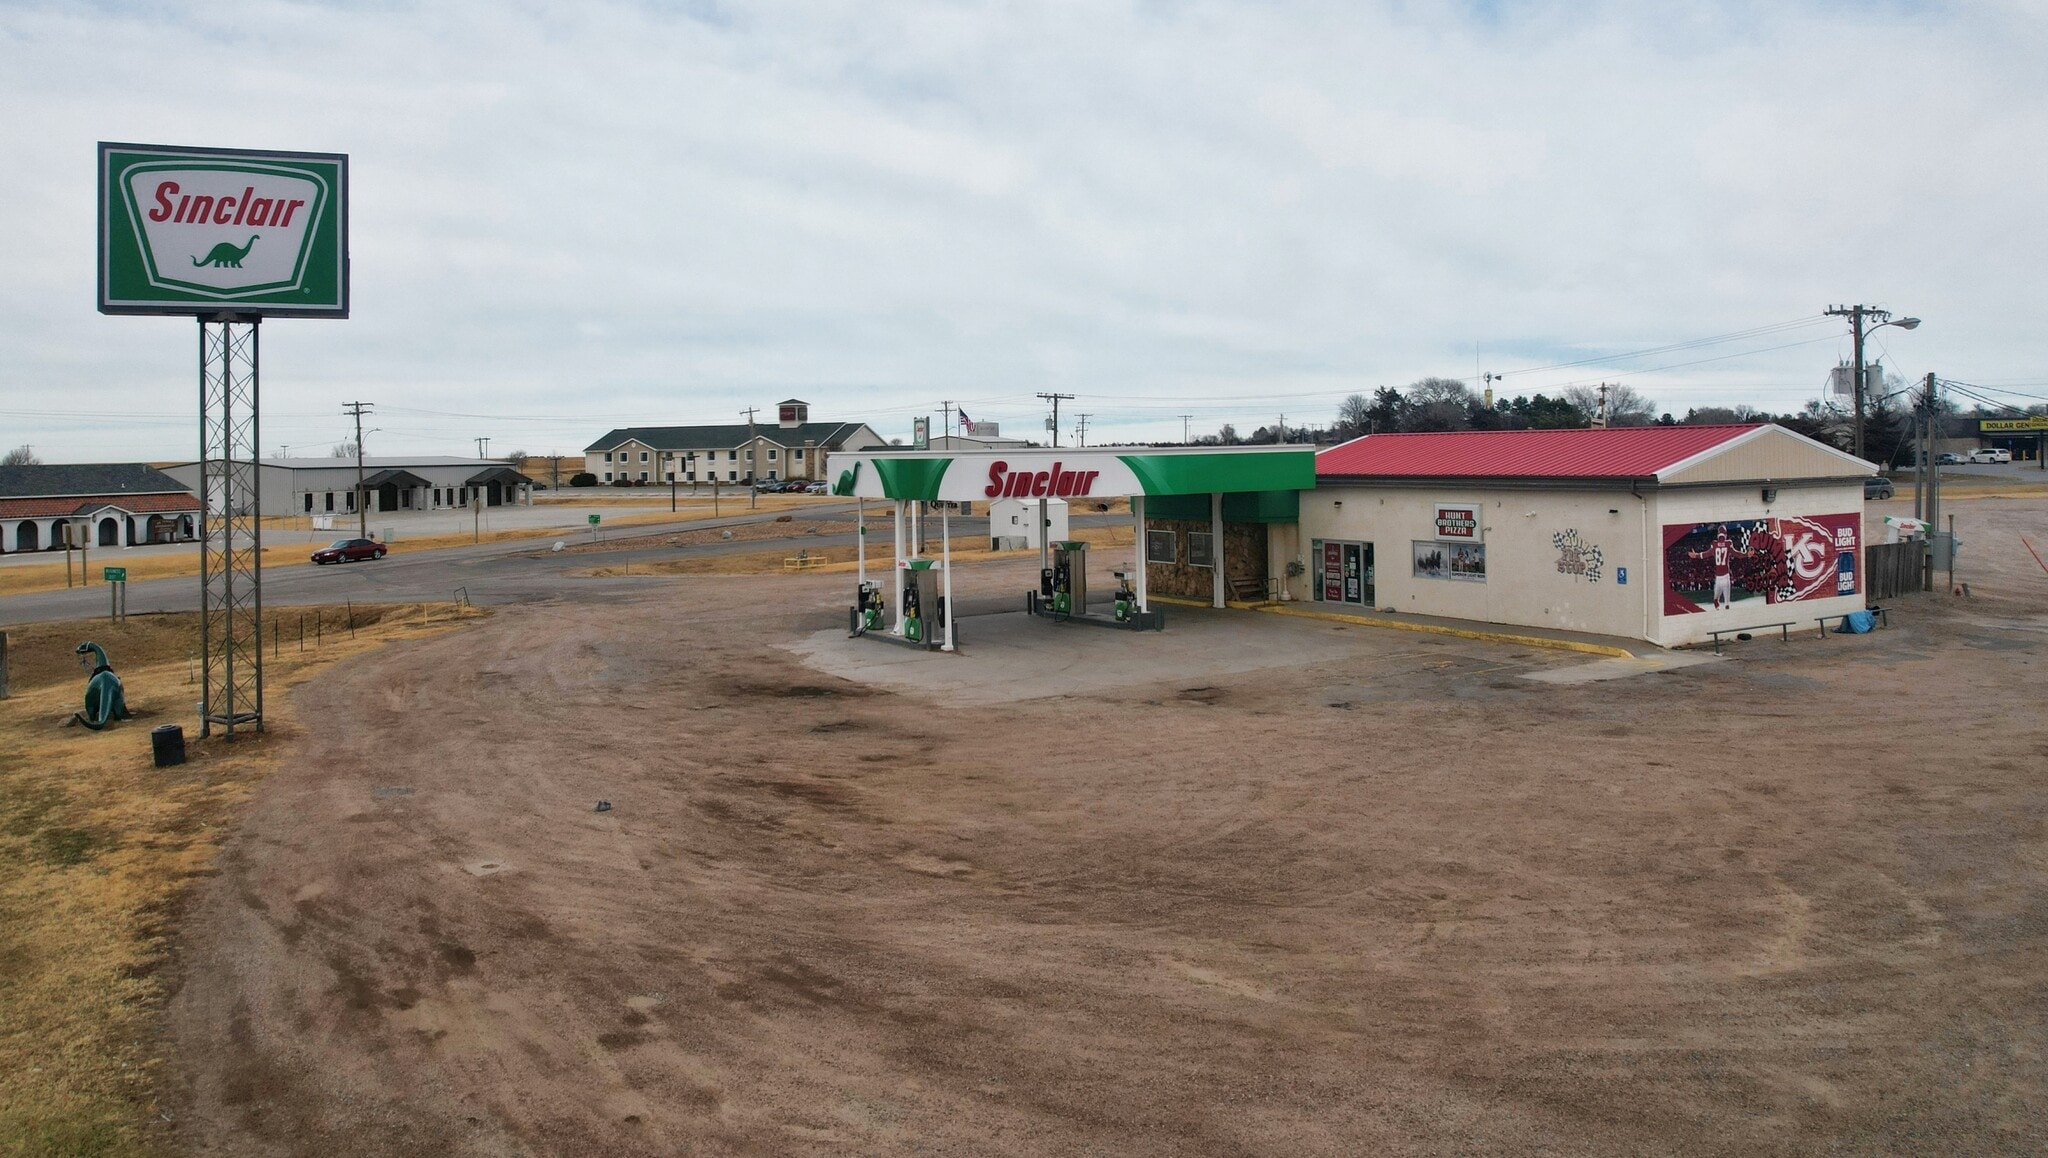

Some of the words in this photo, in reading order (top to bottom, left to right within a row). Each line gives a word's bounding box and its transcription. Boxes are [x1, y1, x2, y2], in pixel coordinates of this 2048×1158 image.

[149, 181, 304, 227] Sinclair
[984, 460, 1099, 498] Sinclair
[1445, 511, 1466, 520] HUNT
[1437, 519, 1475, 528] BROTHERS
[1445, 527, 1467, 535] PIZZA
[1837, 527, 1853, 538] BUD
[1834, 536, 1856, 547] LIGHT
[1714, 547, 1728, 566] 87
[1783, 532, 1826, 580] KC
[1556, 560, 1587, 575] STOP
[1838, 571, 1853, 582] BUD
[1837, 581, 1854, 592] LIGHT
